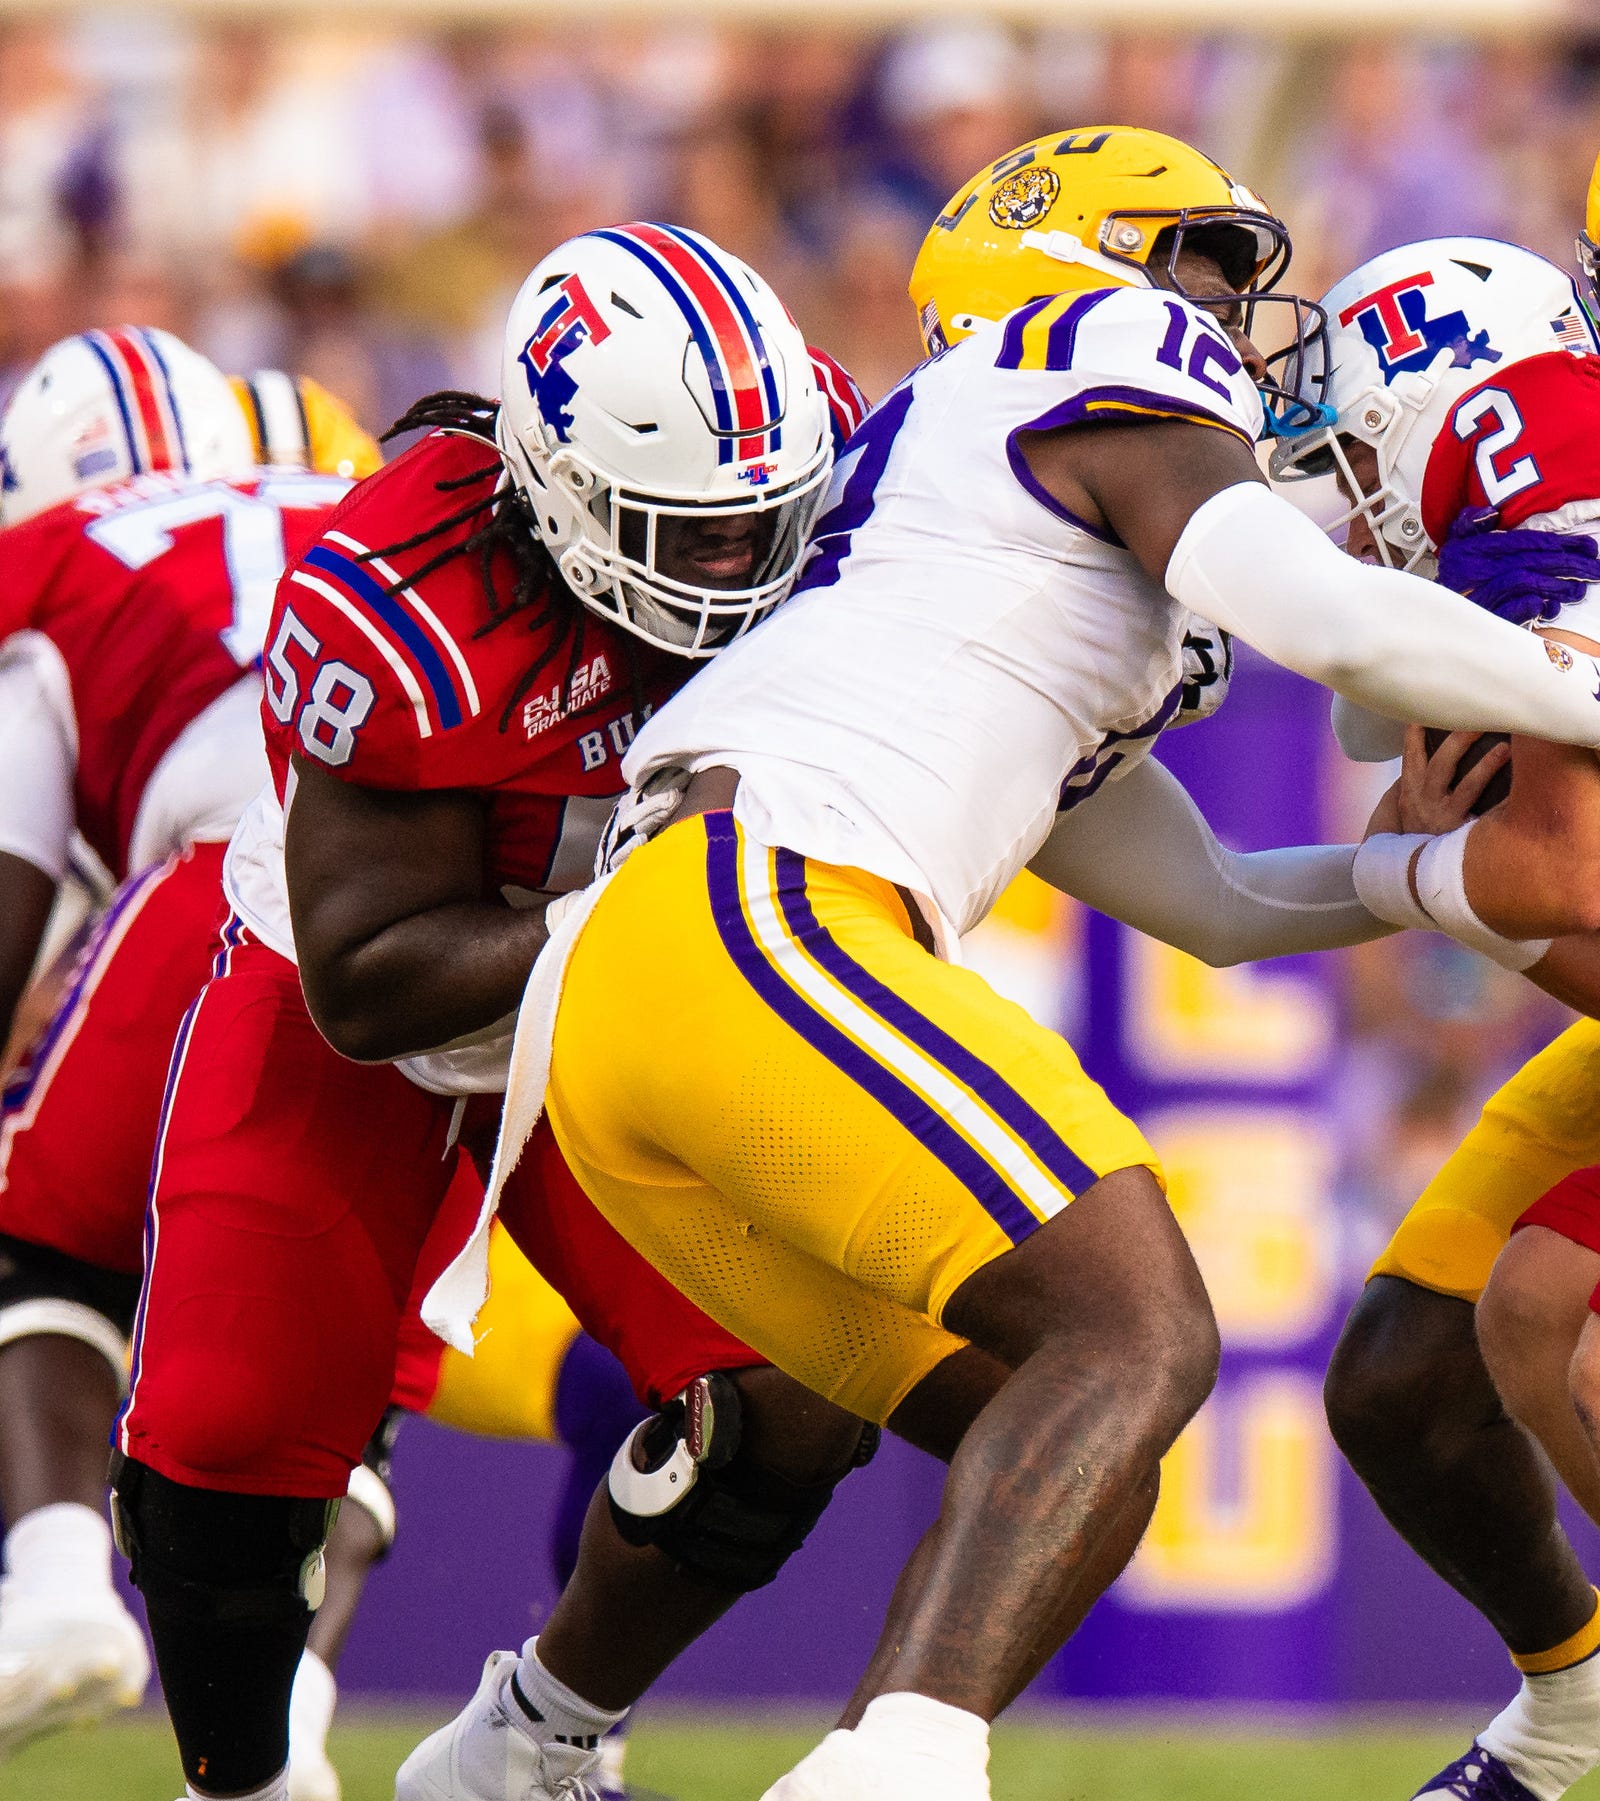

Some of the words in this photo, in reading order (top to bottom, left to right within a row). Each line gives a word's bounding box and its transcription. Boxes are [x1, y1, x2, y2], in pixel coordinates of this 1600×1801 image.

[1156, 300, 1242, 406] 12
[1452, 386, 1545, 508] 2
[264, 603, 377, 768] 58
